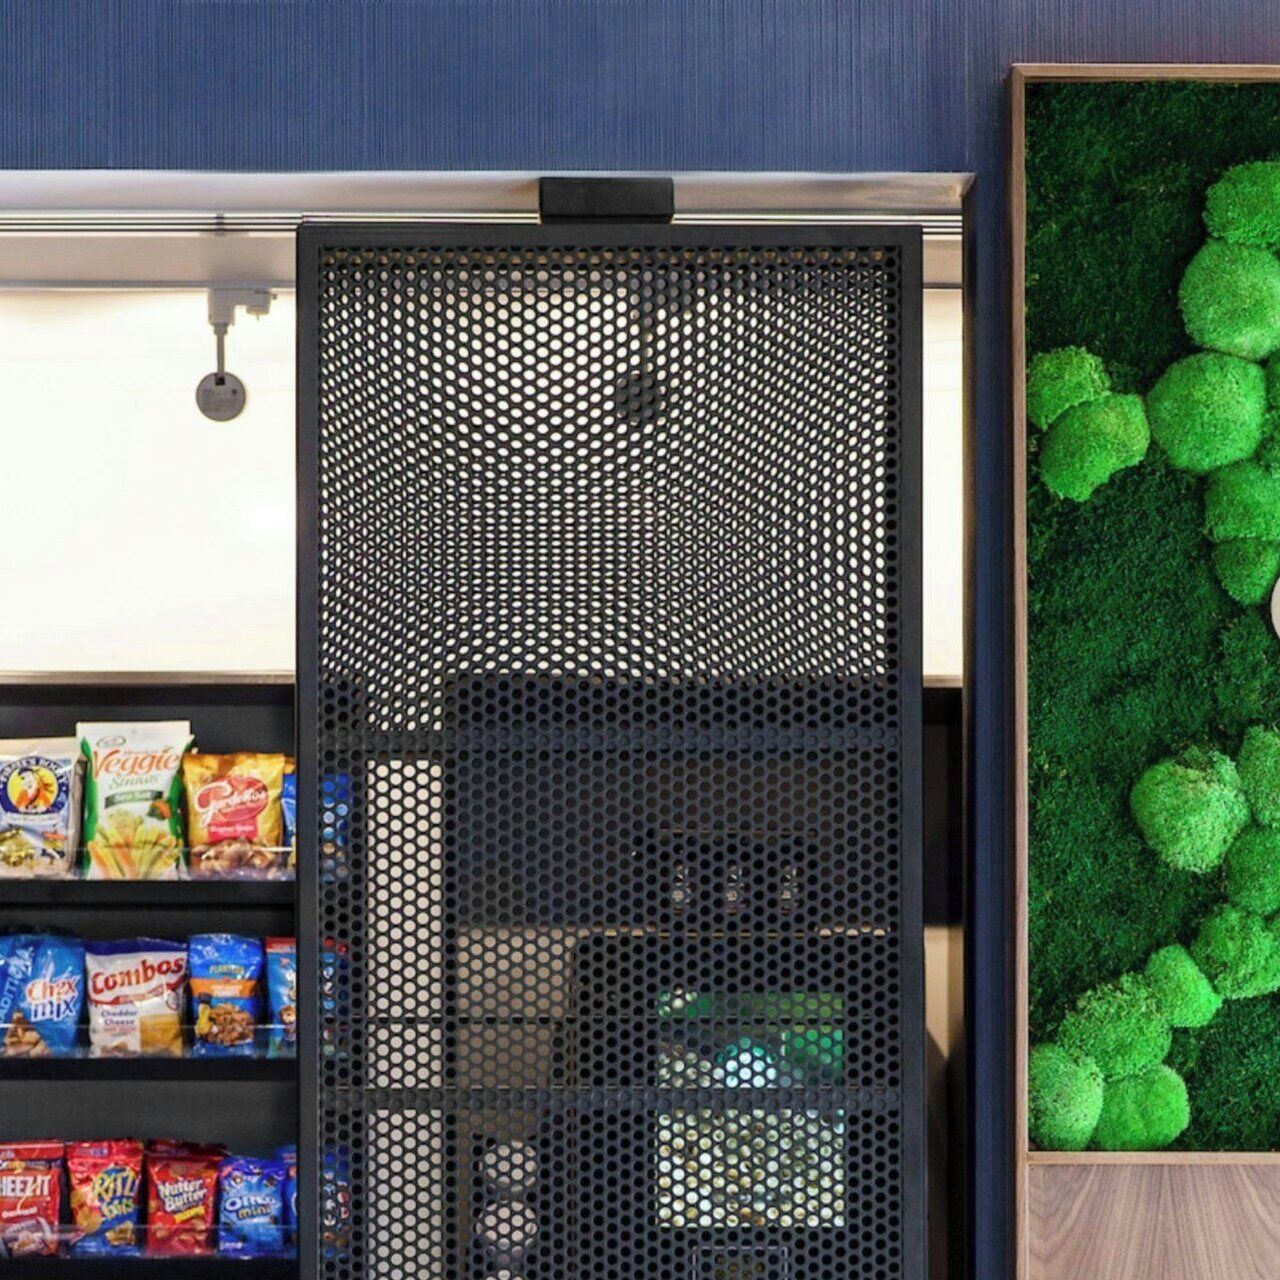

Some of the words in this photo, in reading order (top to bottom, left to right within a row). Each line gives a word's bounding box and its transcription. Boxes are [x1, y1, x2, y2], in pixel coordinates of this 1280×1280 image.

[92, 748, 180, 778] Veggie
[26, 974, 81, 1000] Chex
[91, 957, 185, 995] Combos
[31, 997, 77, 1022] mix
[93, 1165, 139, 1201] RITZ
[157, 1179, 204, 1198] Nutter
[163, 1187, 208, 1212] Butter
